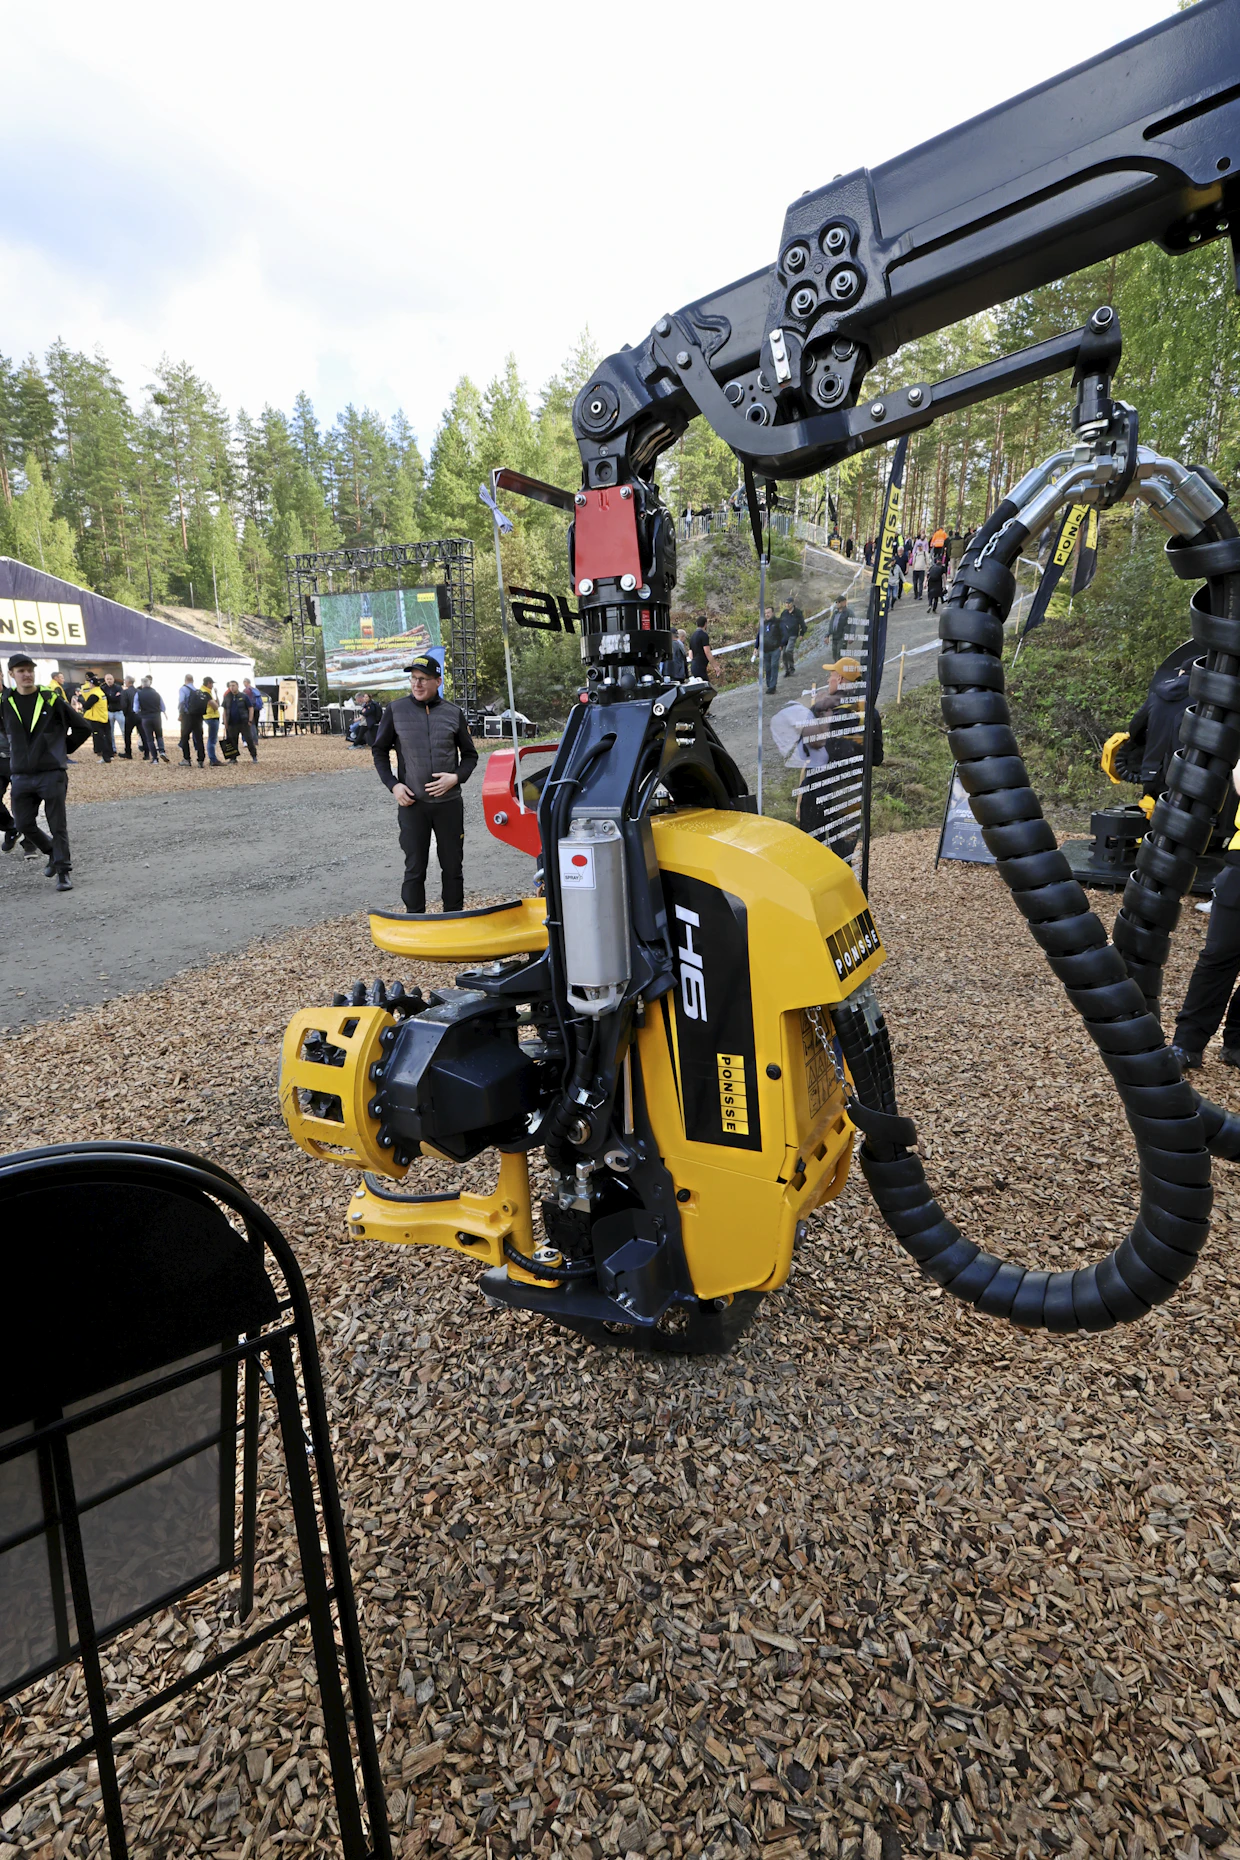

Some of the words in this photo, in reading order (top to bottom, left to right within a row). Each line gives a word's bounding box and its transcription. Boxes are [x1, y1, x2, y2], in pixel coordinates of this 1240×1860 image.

[0, 618, 81, 638] NSSE
[675, 904, 708, 1023] H6
[835, 929, 878, 975] PONSSE
[721, 1056, 737, 1131] PONSSE
